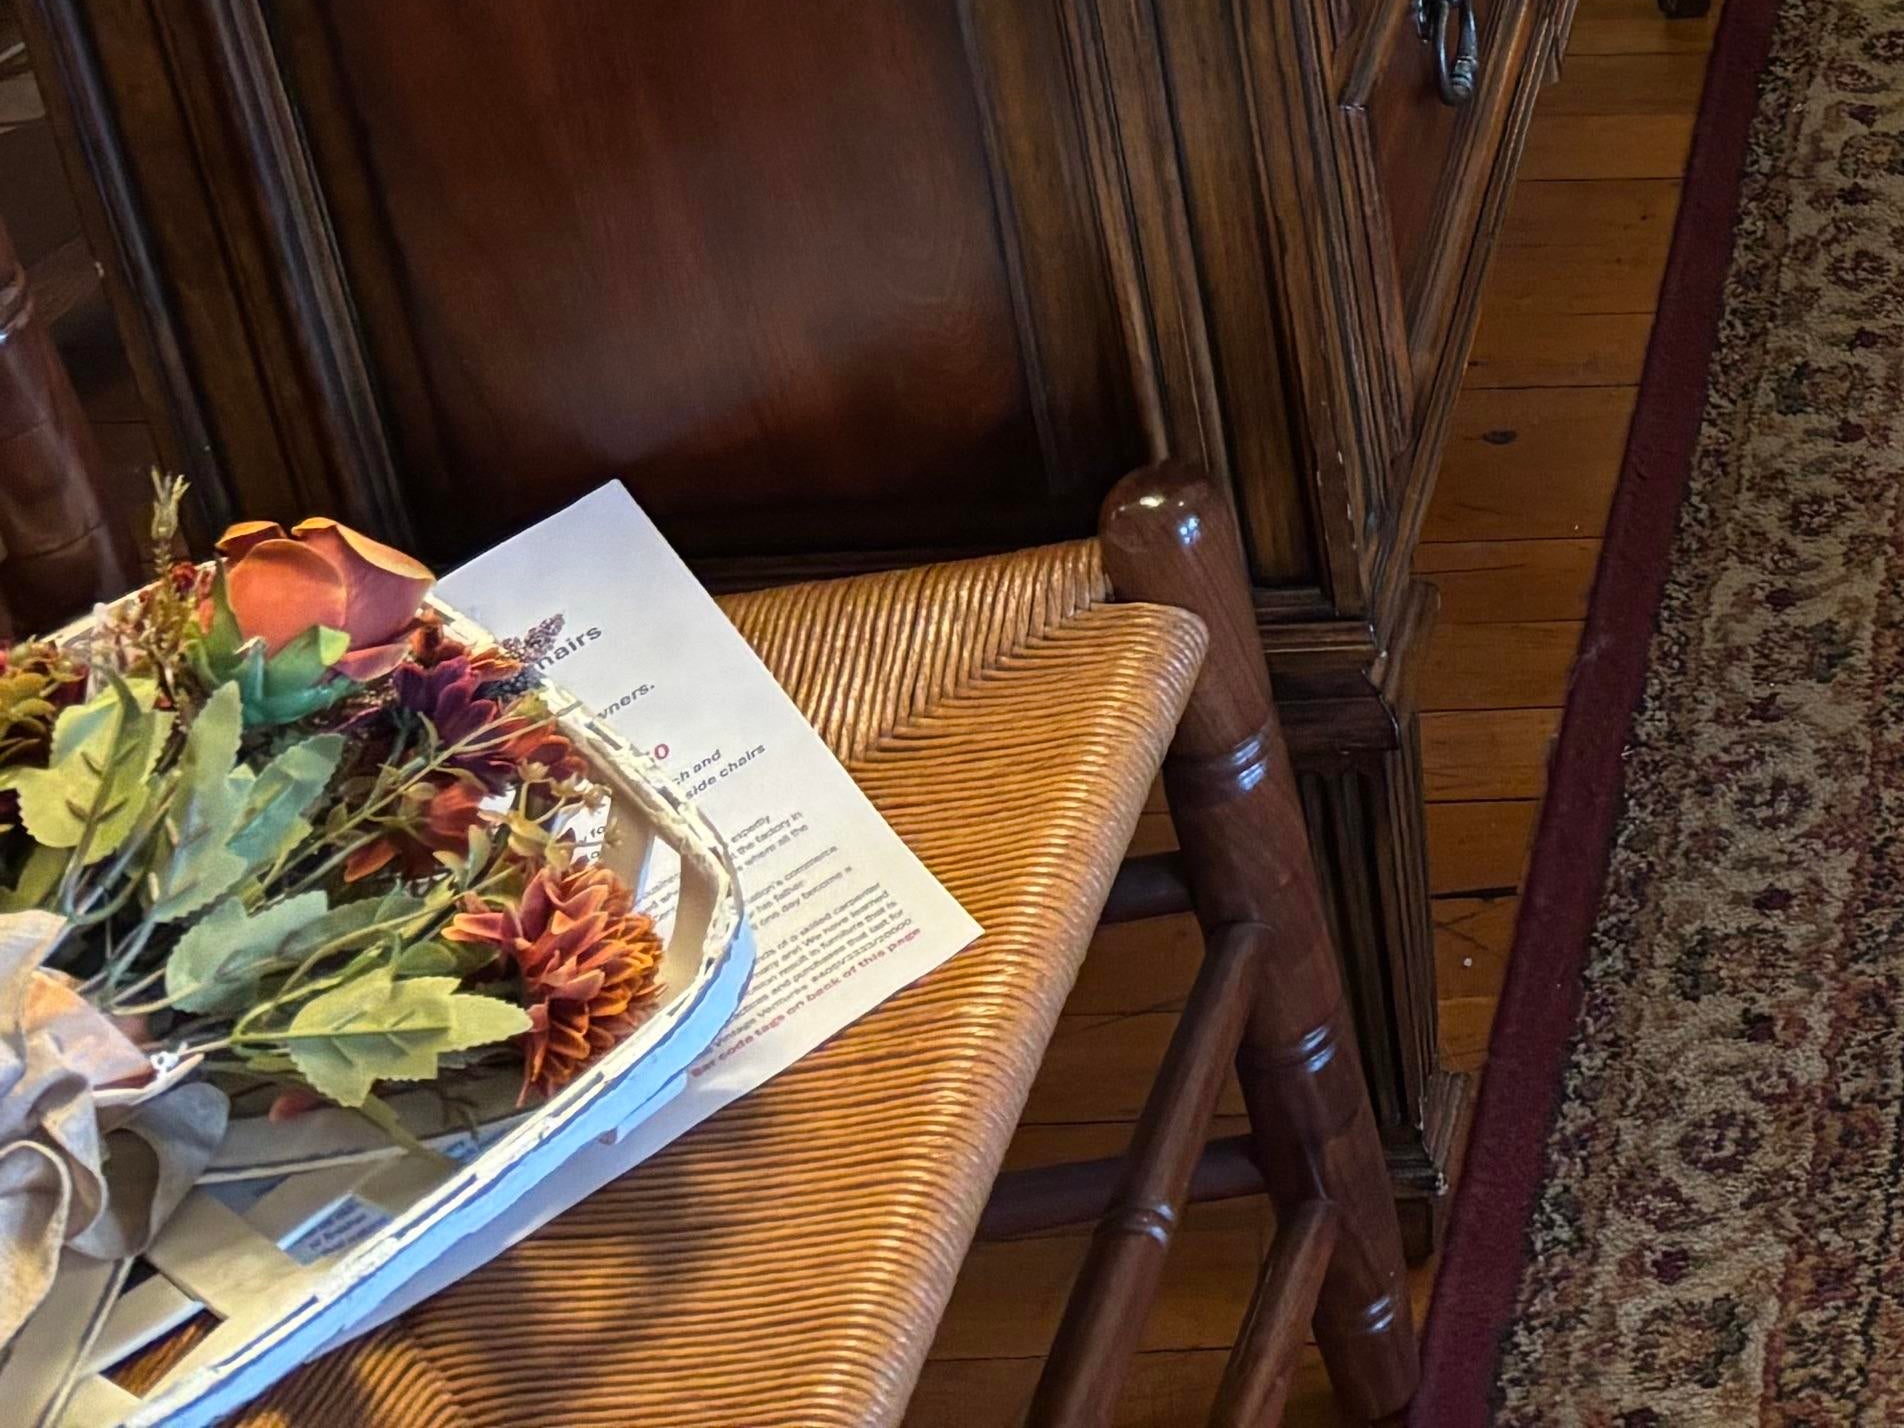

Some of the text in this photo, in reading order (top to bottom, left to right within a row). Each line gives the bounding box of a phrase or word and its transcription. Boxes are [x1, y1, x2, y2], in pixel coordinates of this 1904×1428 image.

[685, 744, 766, 800] side chairs
[693, 749, 722, 773] and
[719, 1037, 754, 1060] code
[755, 1015, 785, 1037] tags
[786, 1000, 804, 1016] on
[807, 978, 841, 1002] back
[842, 968, 857, 980] of
[858, 950, 886, 969] this
[888, 928, 921, 953] page
